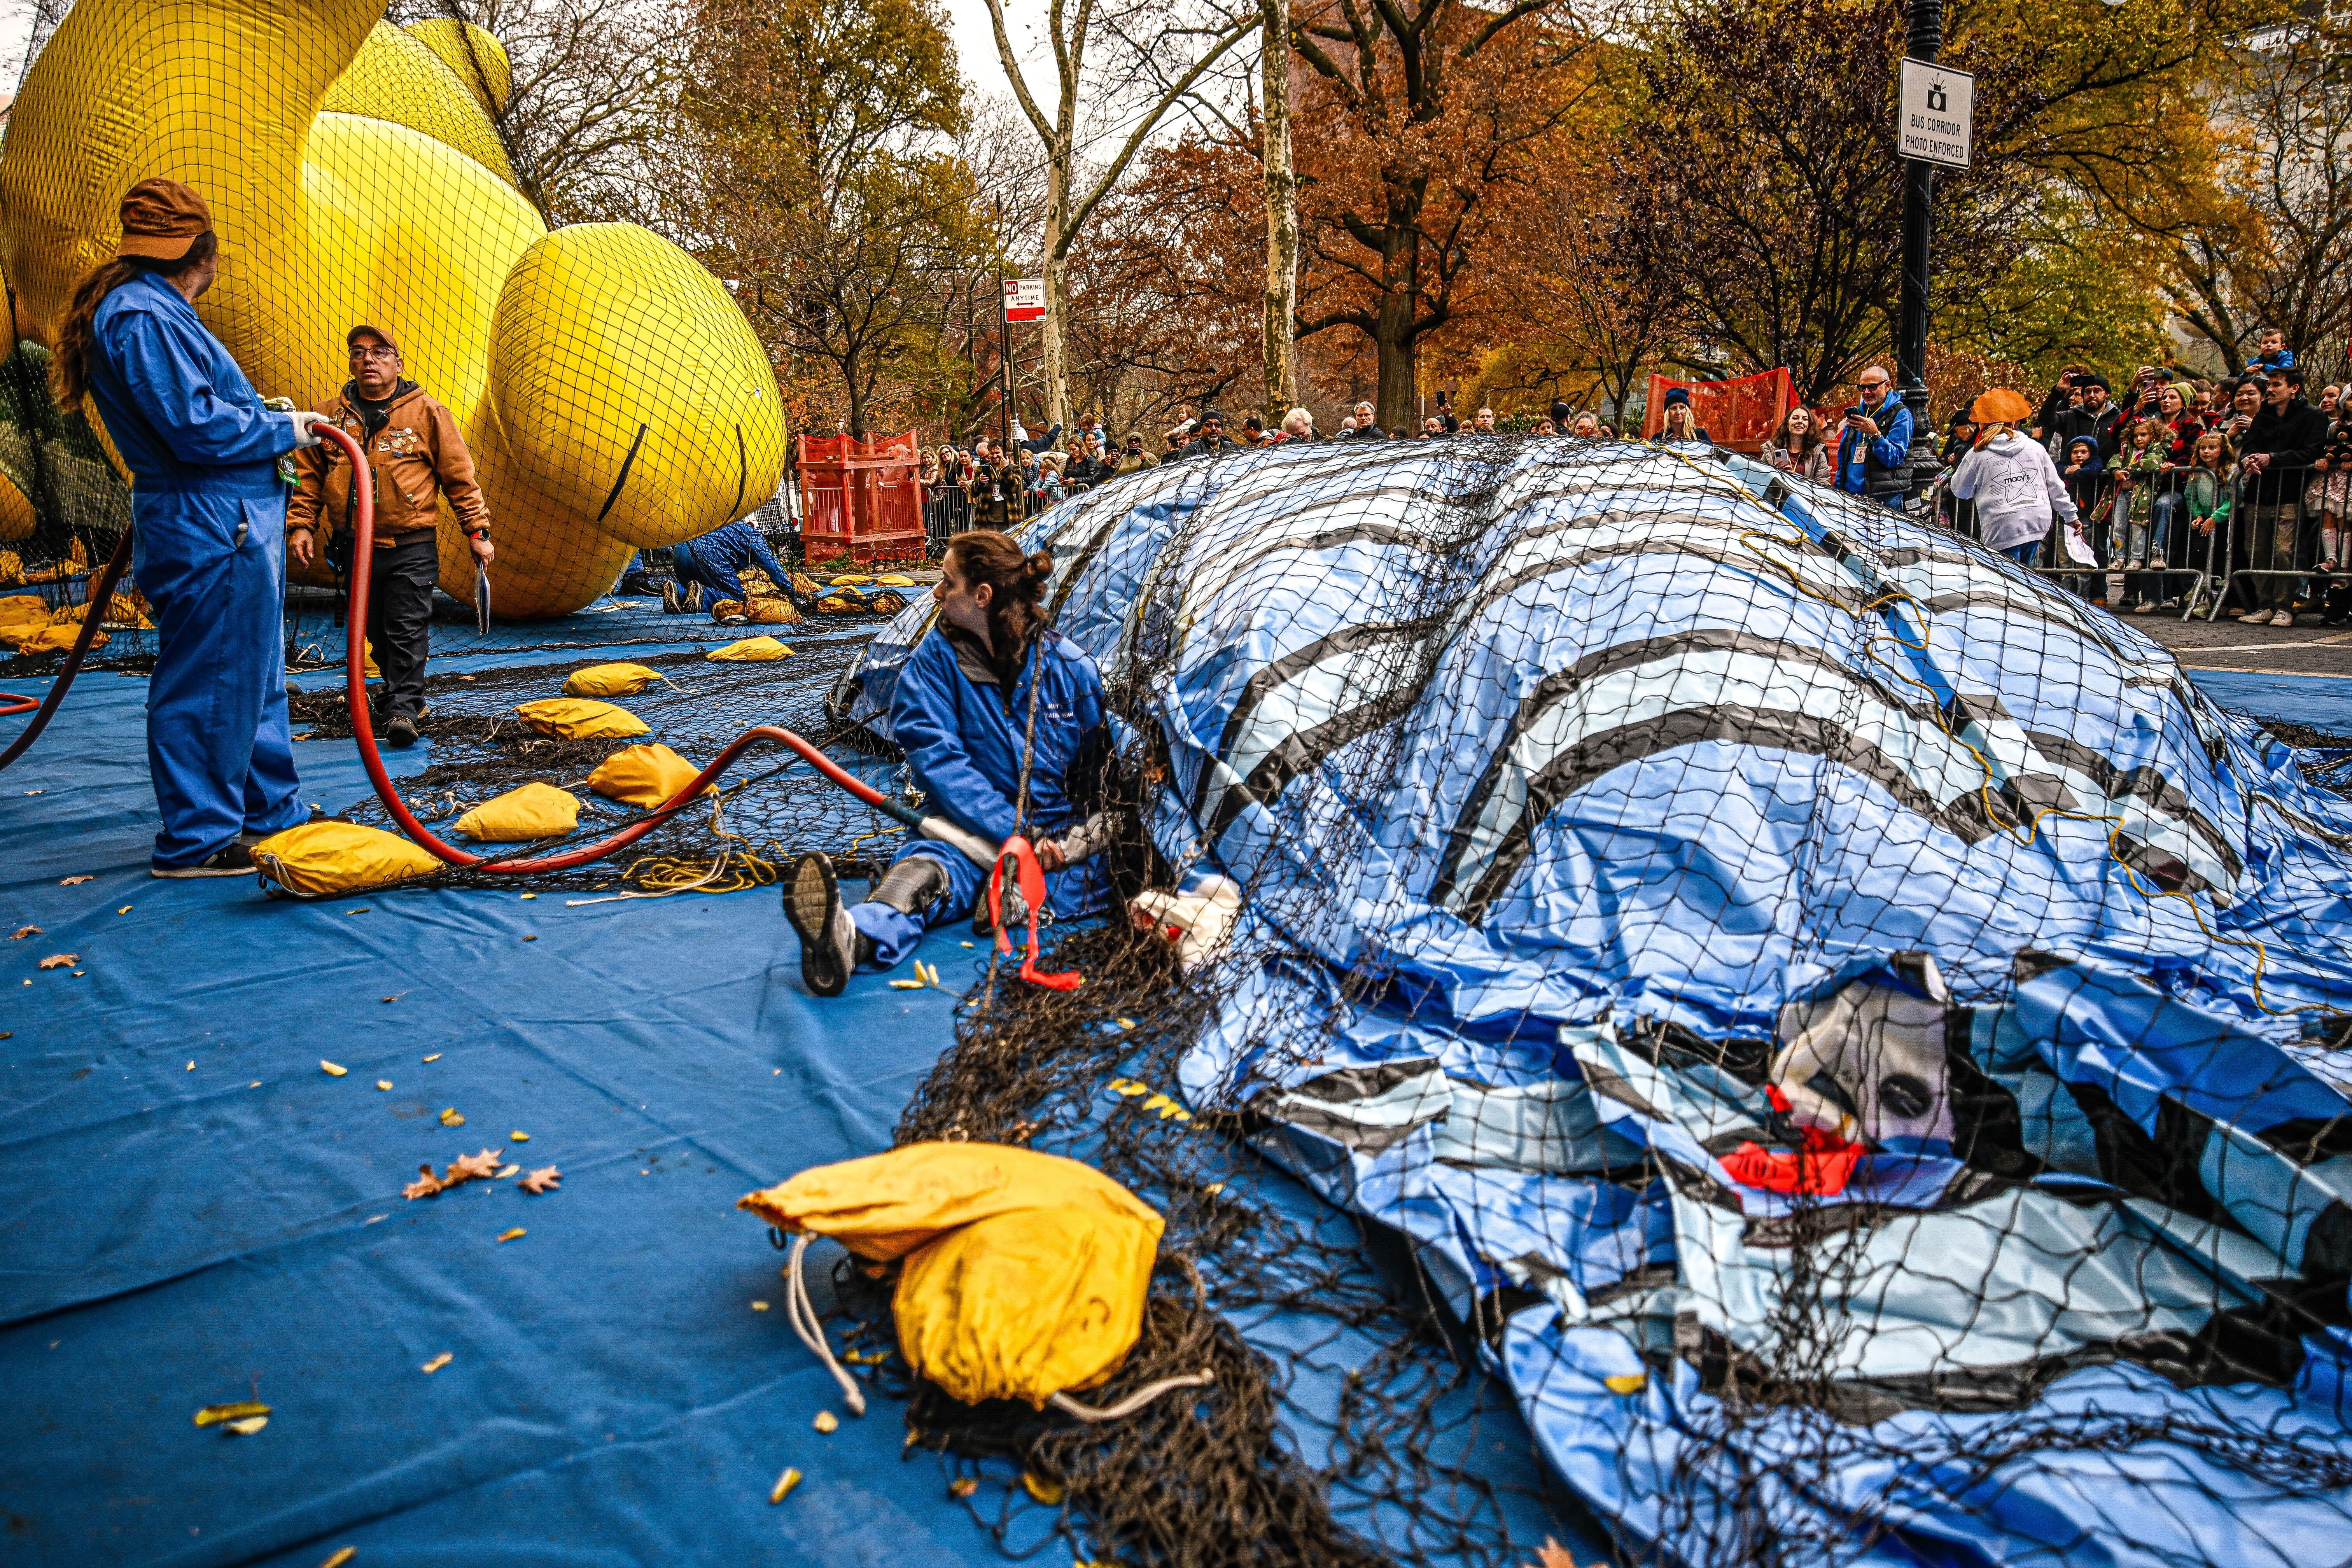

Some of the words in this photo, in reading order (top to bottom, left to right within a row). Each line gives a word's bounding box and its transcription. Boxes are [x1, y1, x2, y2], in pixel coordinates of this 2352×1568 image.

[1911, 114, 1924, 129] BUS
[1927, 118, 1960, 137] CORRIDOR
[1906, 134, 1927, 151] PHOTO
[1929, 140, 1964, 158] ENFORCED
[1006, 284, 1017, 293] NO
[2004, 474, 2030, 484] macy's
